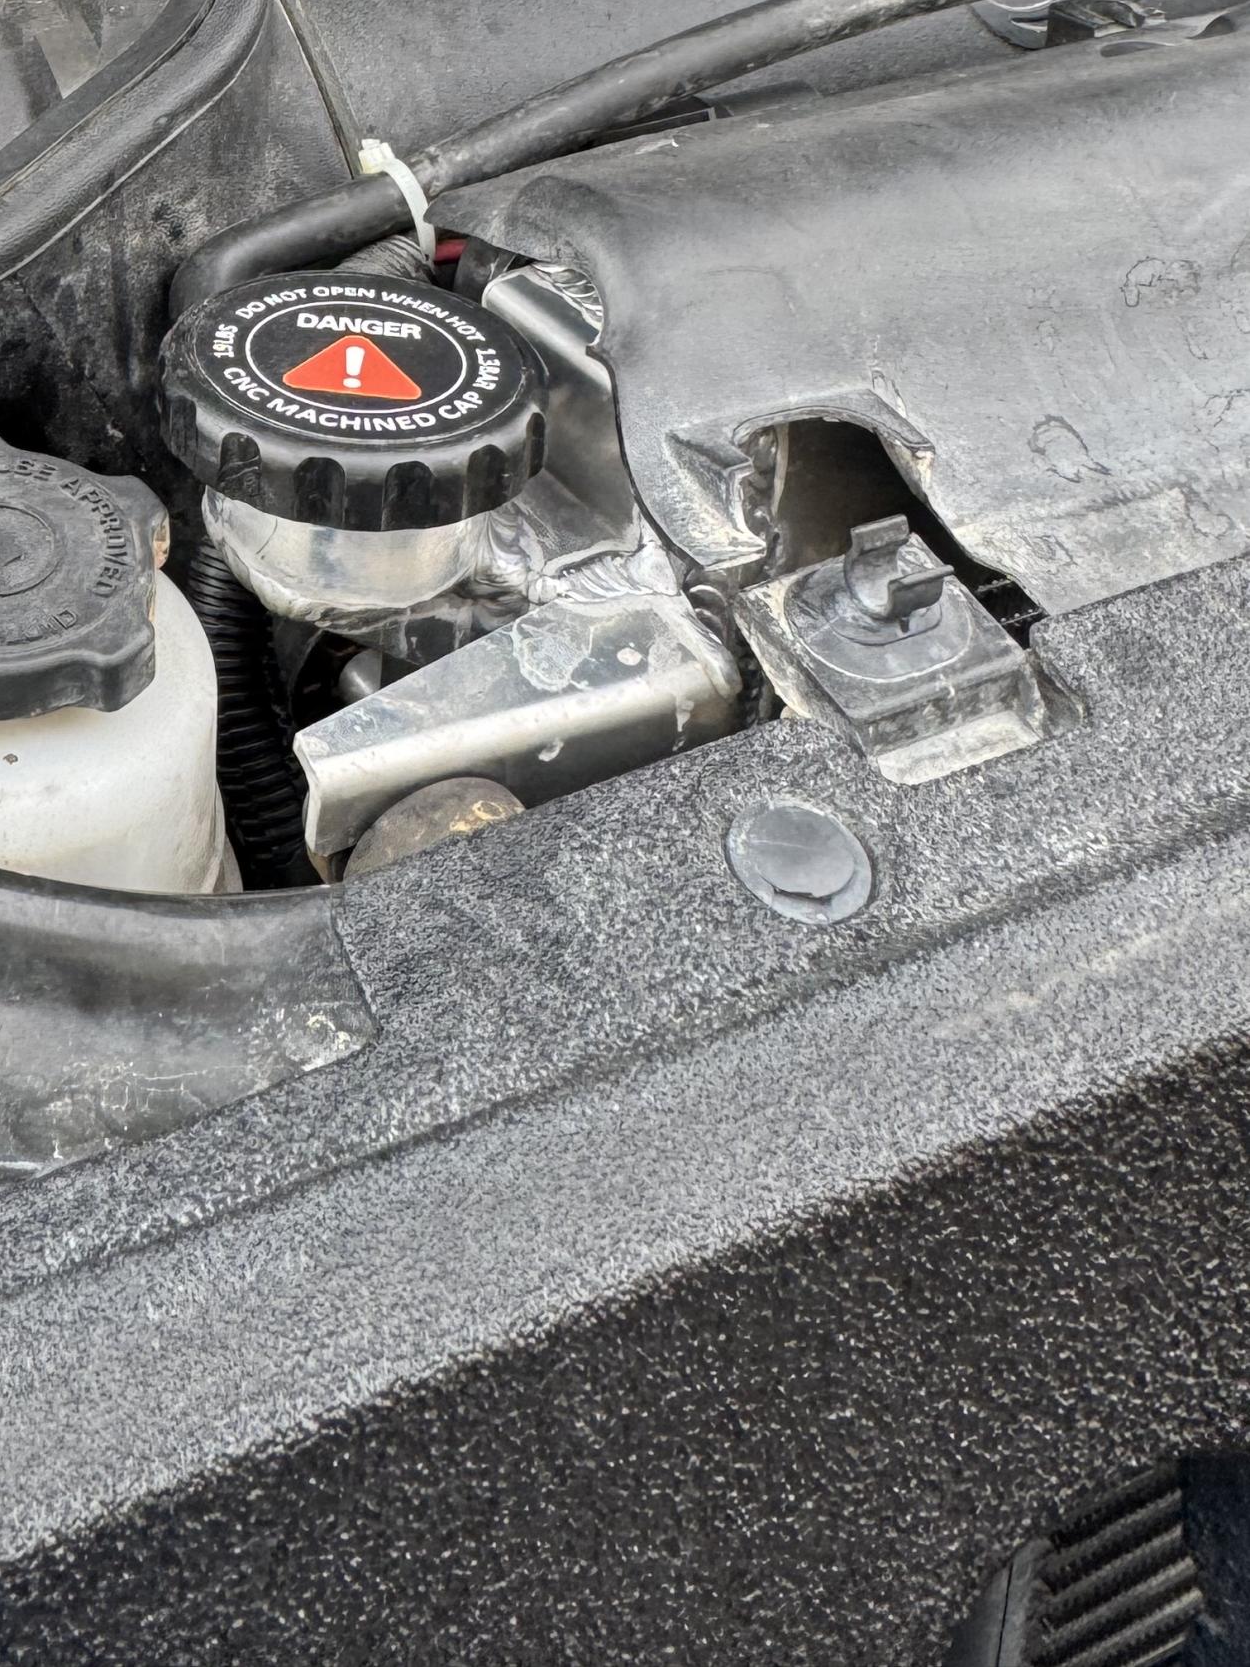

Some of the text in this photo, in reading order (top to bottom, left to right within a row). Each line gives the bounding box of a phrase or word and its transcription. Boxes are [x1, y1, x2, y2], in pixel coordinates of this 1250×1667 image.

[235, 286, 486, 342] DO NOT OPEN WHEN HOT
[297, 313, 422, 340] DANGER
[223, 367, 483, 431] CNC MACHINED CAP
